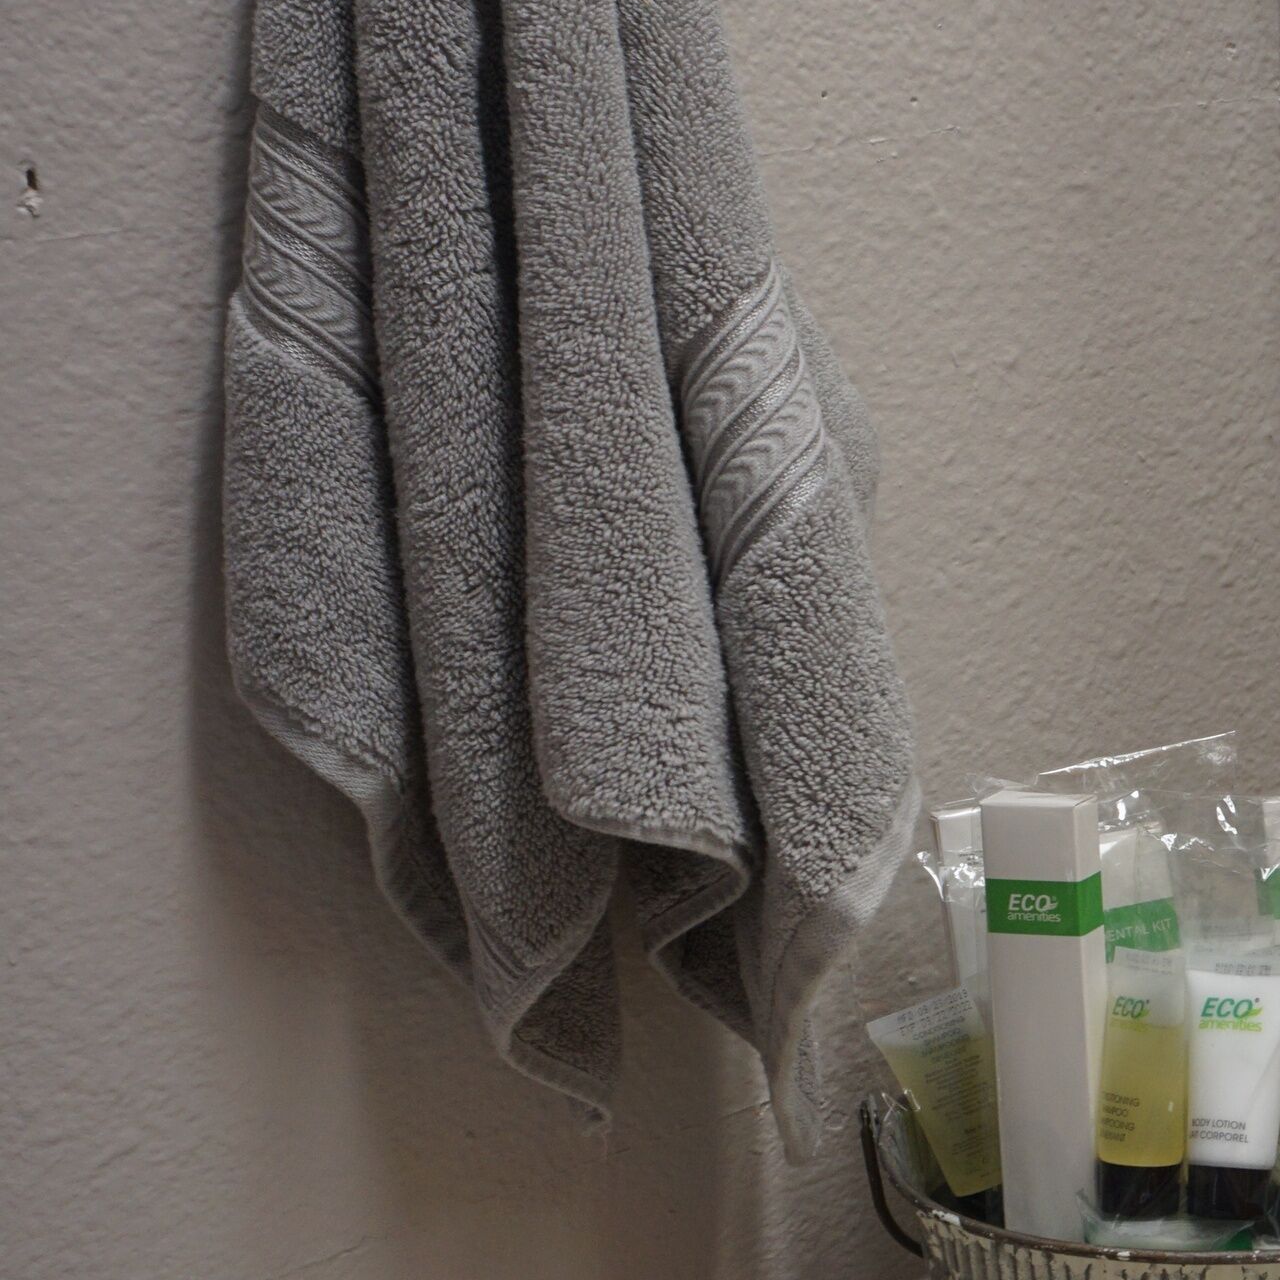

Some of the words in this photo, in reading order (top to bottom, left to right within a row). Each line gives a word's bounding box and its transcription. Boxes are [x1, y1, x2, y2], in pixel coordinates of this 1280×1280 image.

[1008, 893, 1053, 913] ECO
[1007, 911, 1061, 923] amenities
[1106, 925, 1150, 943] ENTAL
[1152, 917, 1172, 933] KIT
[1112, 996, 1147, 1019] ECO
[1200, 997, 1257, 1019] ECO
[1199, 1019, 1263, 1033] amenities
[1191, 1119, 1210, 1128] BODY
[1212, 1119, 1246, 1130] LOTION
[1200, 1131, 1248, 1143] CORPOREL
